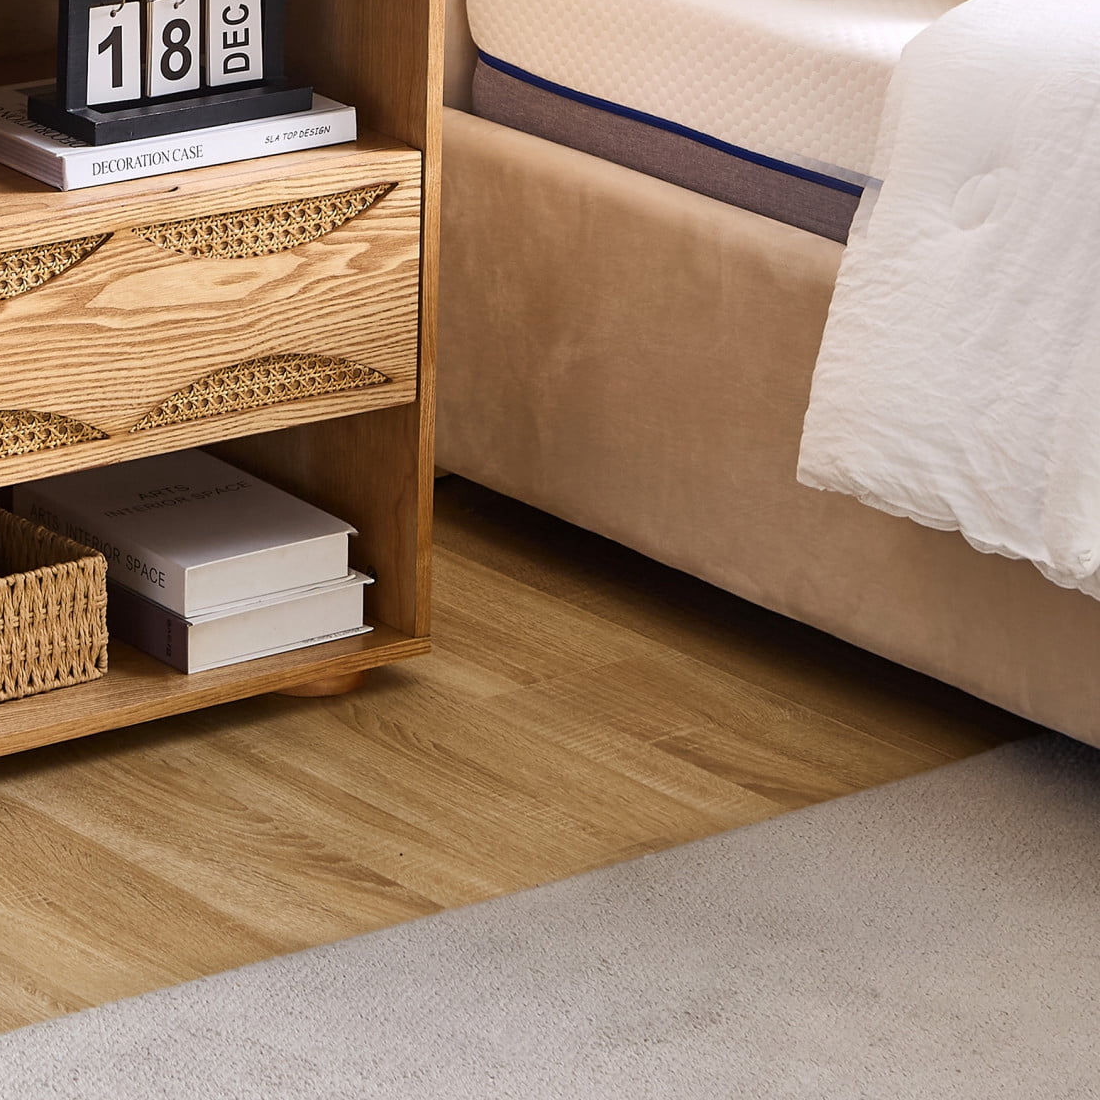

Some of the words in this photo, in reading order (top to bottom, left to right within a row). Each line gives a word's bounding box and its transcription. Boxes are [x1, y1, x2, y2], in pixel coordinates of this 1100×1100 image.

[221, 3, 250, 75] DEC
[264, 133, 280, 144] SLA
[283, 130, 298, 141] TOP
[298, 125, 331, 139] DESIGN
[91, 149, 170, 176] DECORATION
[172, 144, 204, 162] CASE
[103, 496, 191, 518] INTERIOR
[191, 480, 252, 500] SPACE
[138, 484, 190, 501] ARTS
[125, 554, 166, 589] SPACE
